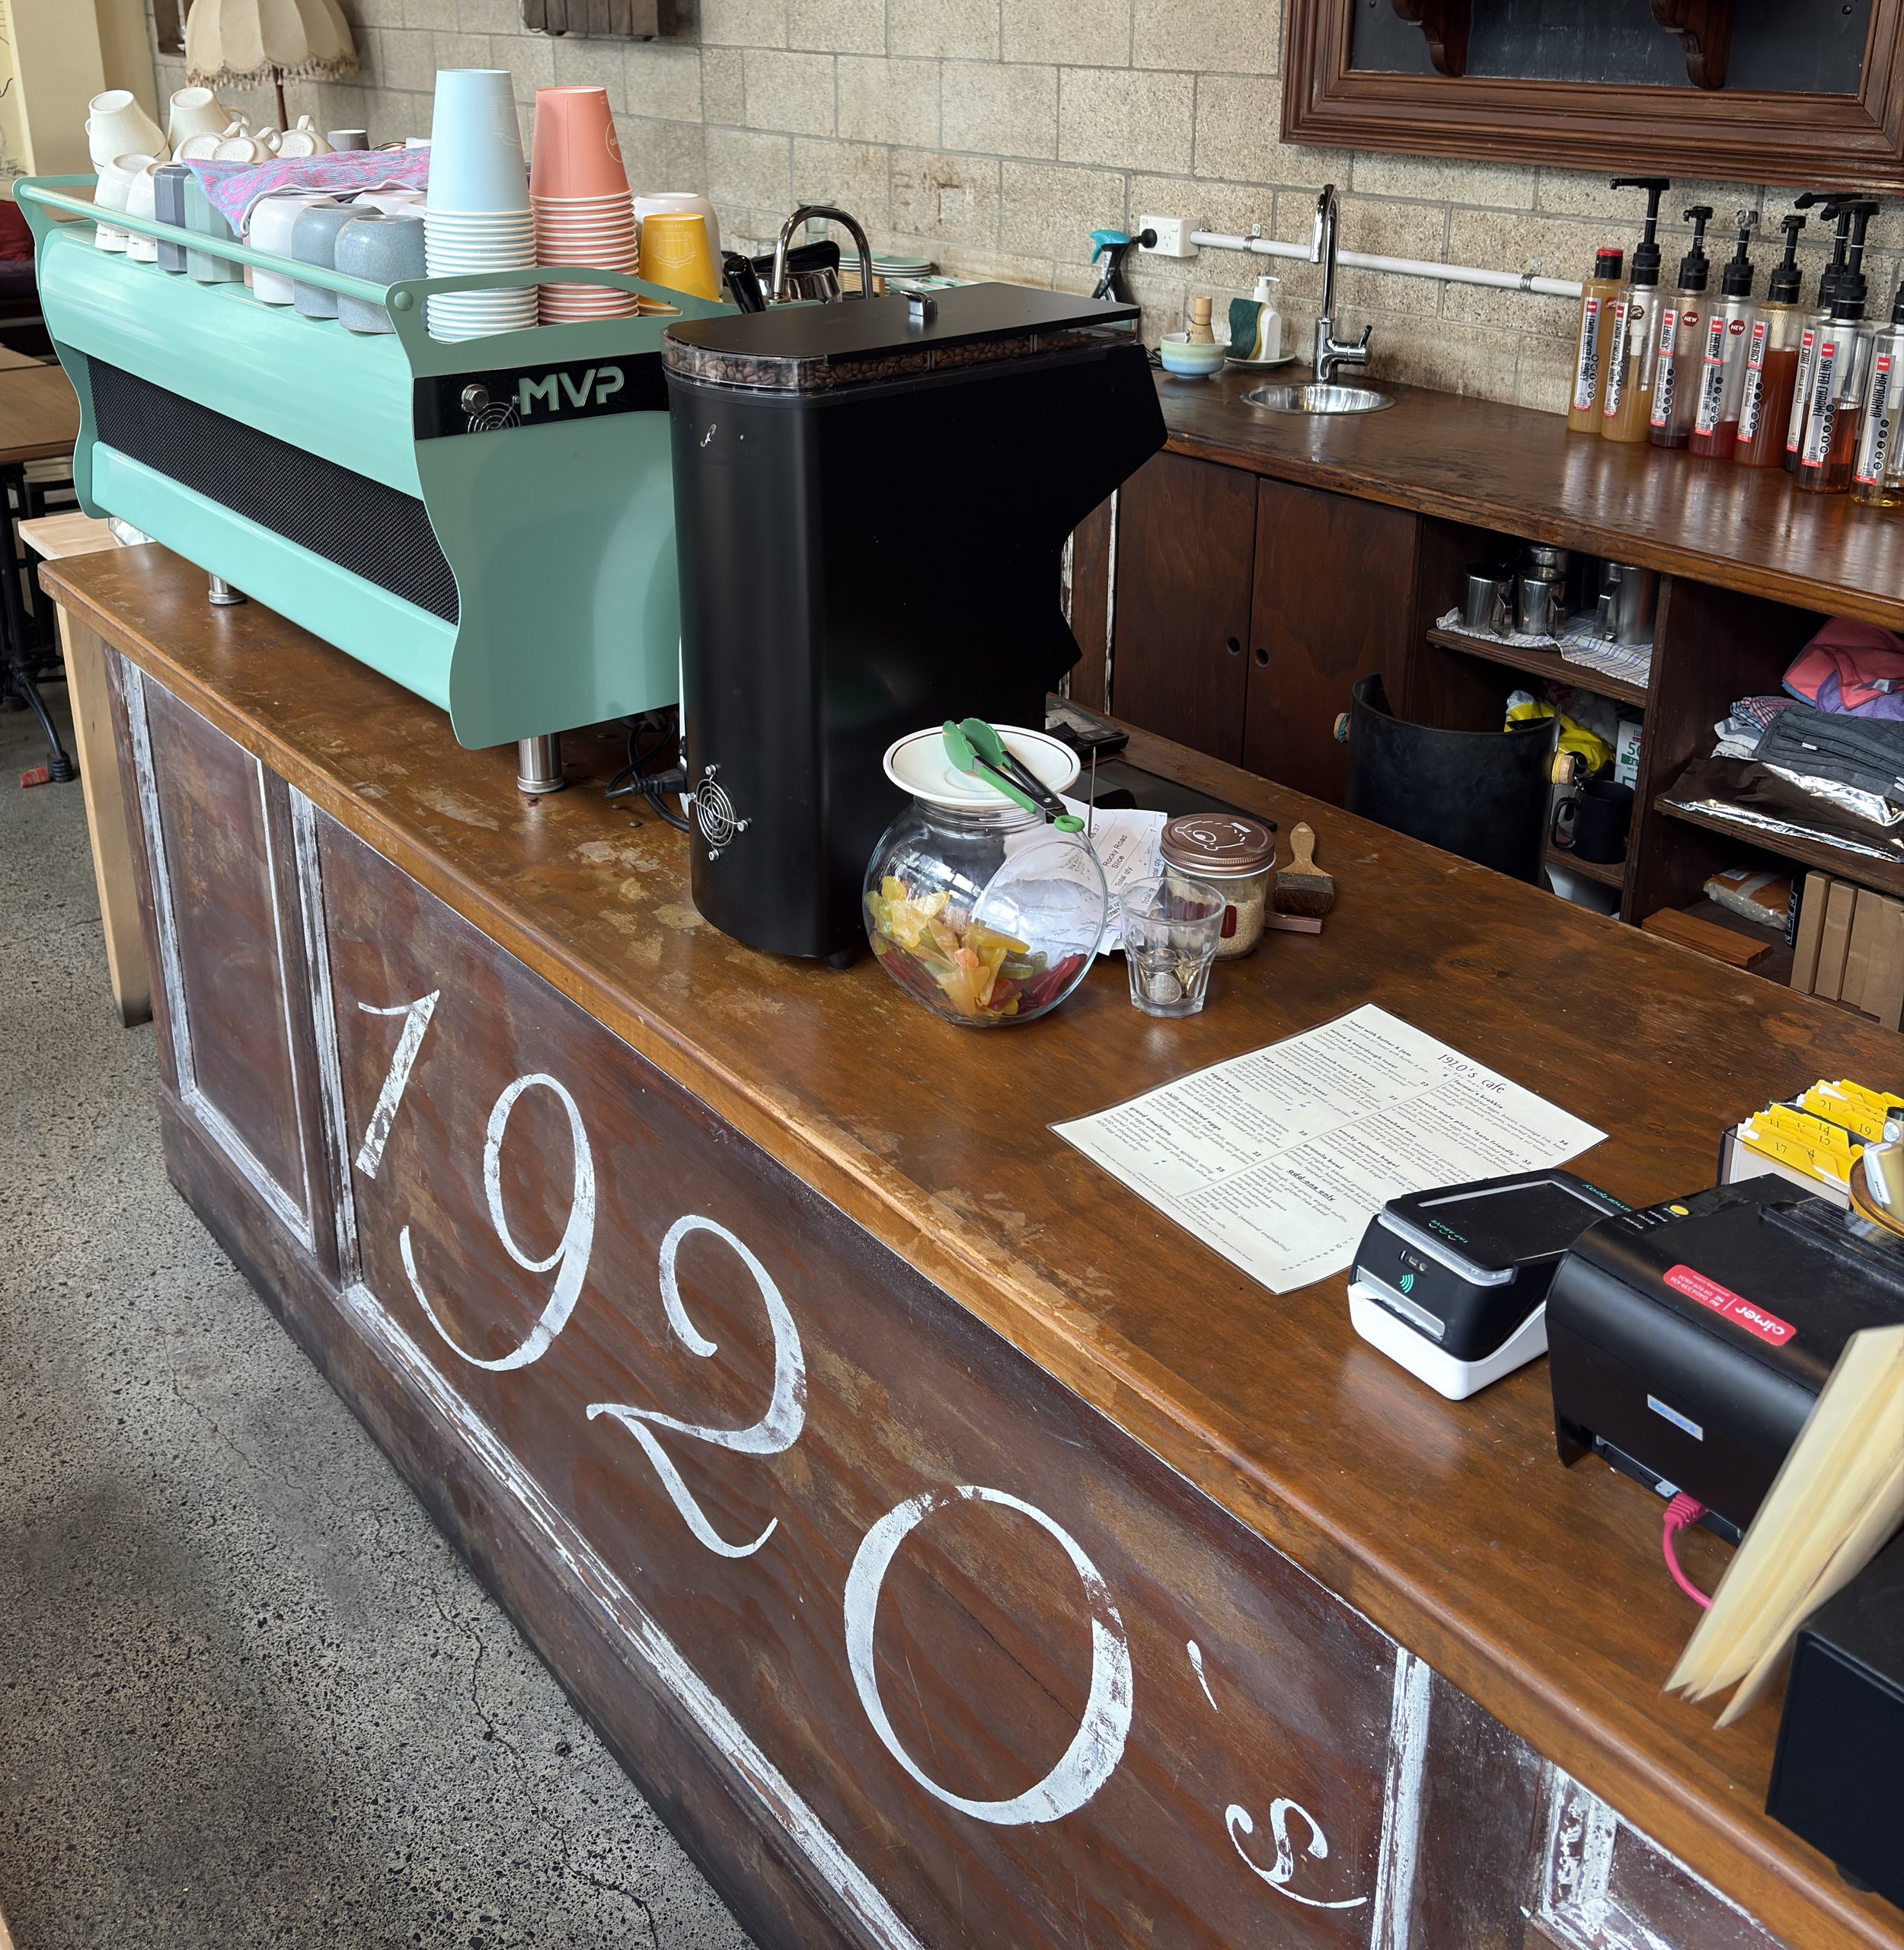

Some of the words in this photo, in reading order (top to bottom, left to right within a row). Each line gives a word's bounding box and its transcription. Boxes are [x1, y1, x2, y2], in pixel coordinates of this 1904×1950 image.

[1661, 326, 1674, 349] ENERGY
[1750, 337, 1762, 363] ENERGY
[1800, 348, 1810, 365] CHAI
[1818, 359, 1832, 385] SALTED
[519, 366, 625, 415] MVP
[1813, 385, 1828, 416] CARAMEL
[1870, 373, 1888, 418] MACADAMIA
[1103, 847, 1118, 866] Rocky
[1115, 835, 1127, 850] Road
[1111, 855, 1125, 869] Slice
[1115, 873, 1127, 887] Total
[1349, 1020, 1364, 1029] toast
[1376, 1035, 1394, 1046] butter
[1329, 1029, 1347, 1039] mince
[1352, 1042, 1382, 1059] sourdough
[1382, 1059, 1398, 1068] toast
[1260, 1055, 1274, 1064] eggs
[1283, 1068, 1311, 1087] sourdough
[1311, 1086, 1327, 1096] toast
[1299, 1041, 1320, 1053] biscoff
[1318, 1052, 1337, 1064] french
[1336, 1064, 1353, 1073] toast
[1357, 1076, 1375, 1087] bacon
[1436, 1054, 1478, 1077] 1920's
[1481, 1080, 1506, 1093] cafe
[1210, 1073, 1224, 1081] eggs
[1224, 1080, 1241, 1093] benny
[1453, 1080, 1479, 1095] farmer's
[1479, 1094, 1503, 1109] brekkie
[1164, 1092, 1180, 1101] chilli
[1178, 1101, 1209, 1120] scrambled
[1206, 1120, 1221, 1130] eggs
[1416, 1098, 1437, 1110] muscle
[1437, 1110, 1454, 1120] mate
[1452, 1120, 1471, 1130] plate
[1820, 1099, 1832, 1108] 21
[1128, 1106, 1148, 1117] grand
[1145, 1117, 1171, 1135] omellette
[1377, 1113, 1406, 1130] smashed
[1819, 1122, 1830, 1136] 14
[1859, 1123, 1871, 1136] 19
[1302, 1144, 1327, 1159] granola
[1327, 1158, 1344, 1170] bowl
[1337, 1129, 1357, 1141] smoky
[1357, 1141, 1379, 1156] salmon
[1379, 1155, 1400, 1167] bagel
[1775, 1142, 1787, 1154] 17
[1286, 1168, 1321, 1190] add-ons
[1316, 1189, 1338, 1202] only
[1430, 1220, 1455, 1234] ABOVE
[1622, 1217, 1644, 1229] Power
[1637, 1214, 1655, 1224] Error
[1454, 1234, 1468, 1243] TAP
[1709, 1299, 1721, 1307] AU
[1735, 1307, 1784, 1336] aimer
[356, 990, 1367, 1908] 1920's
